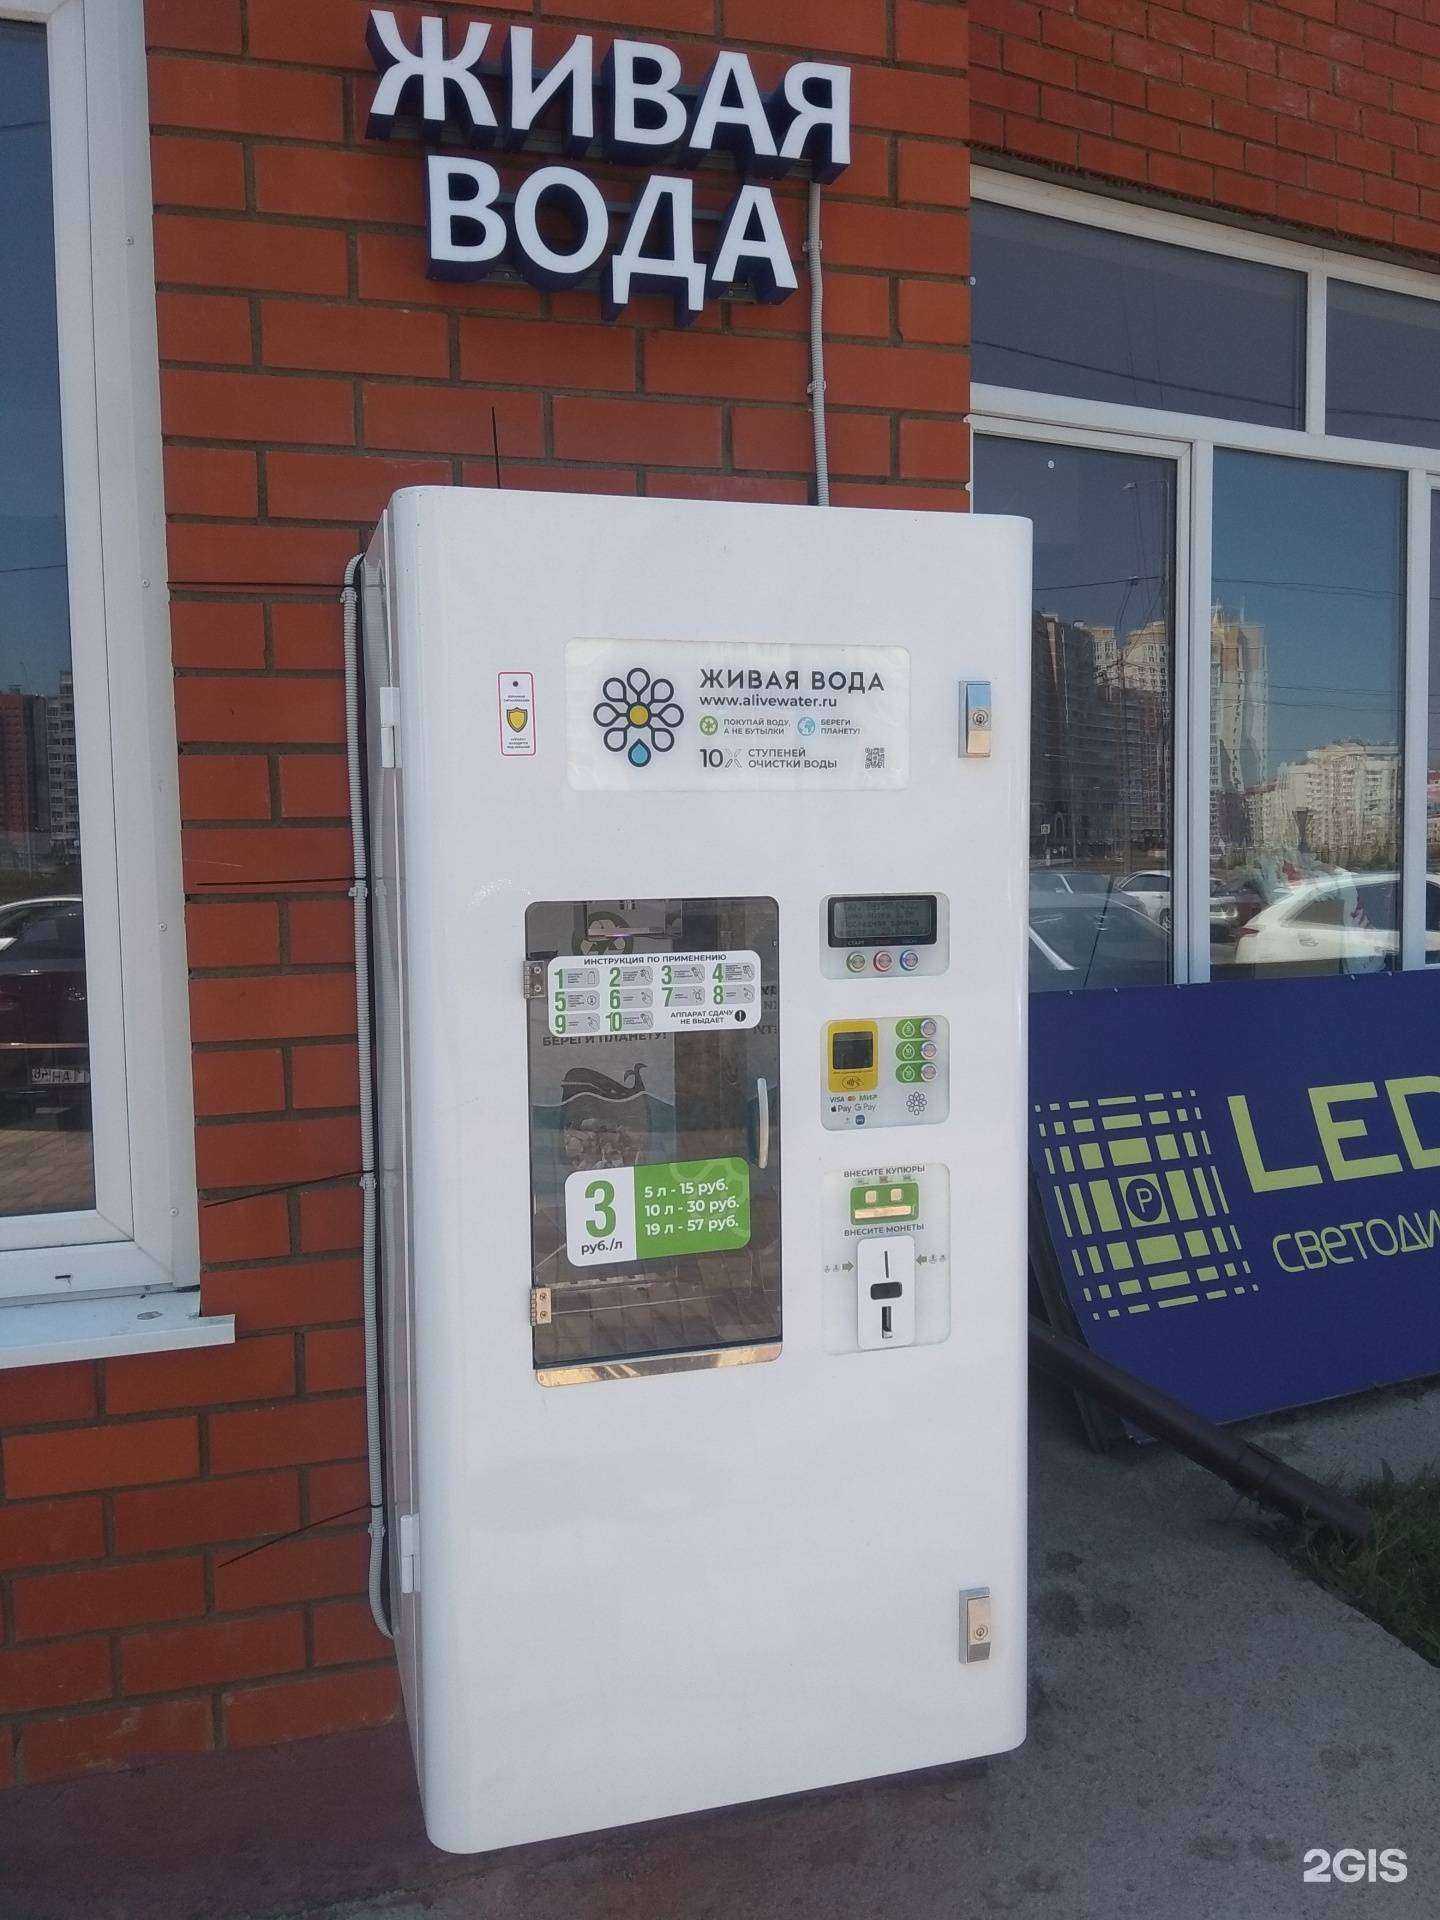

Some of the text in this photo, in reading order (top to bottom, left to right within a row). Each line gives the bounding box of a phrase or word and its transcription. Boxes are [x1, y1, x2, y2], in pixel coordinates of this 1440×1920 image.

[369, 9, 852, 166] ЖИВАЯ
[427, 155, 799, 312] ВОДА
[699, 668, 885, 695] ЖИВАЯ ВОДА
[699, 693, 838, 708] www.alivewater.ru
[723, 718, 765, 726] ПОКУПАЙ
[820, 718, 851, 726] БЕРЕГИ
[748, 747, 806, 758] СТУПЕНЕЙ
[748, 759, 838, 770] ОЧИСТКИ ВОДЫ
[583, 953, 727, 966] ИНСТРУКЦИЯ ПО ПРИМЕНЕНИЮ
[554, 968, 564, 989] 1
[609, 967, 621, 987] 2
[661, 965, 672, 985] 3
[712, 963, 724, 983] 4
[555, 991, 566, 1012] 5
[609, 989, 621, 1010] 6
[661, 986, 673, 1007] 7
[713, 985, 724, 1005] 8
[605, 1011, 622, 1032] 10
[670, 1009, 734, 1018] АППАРАТ СДАЧУ
[692, 1017, 724, 1025] ВЫДАЕТ
[554, 1014, 566, 1034] 9
[843, 1165, 926, 1178] ВНЕСИТЕ КУПЮРЫ
[644, 1186, 653, 1198] 5
[656, 1187, 667, 1198] л
[680, 1182, 694, 1195] 15
[698, 1178, 729, 1196] руб.
[584, 1179, 617, 1238] 3
[644, 1204, 660, 1217] 10
[664, 1205, 674, 1215] л
[686, 1199, 706, 1213] 30
[709, 1195, 740, 1213] руб.
[644, 1222, 660, 1236] 19
[664, 1223, 674, 1234] л
[686, 1218, 705, 1232] 57
[708, 1214, 739, 1232] руб.
[843, 1223, 925, 1237] ВНЕСИТЕ МОНЕТЫ
[580, 1237, 623, 1256] руб./л
